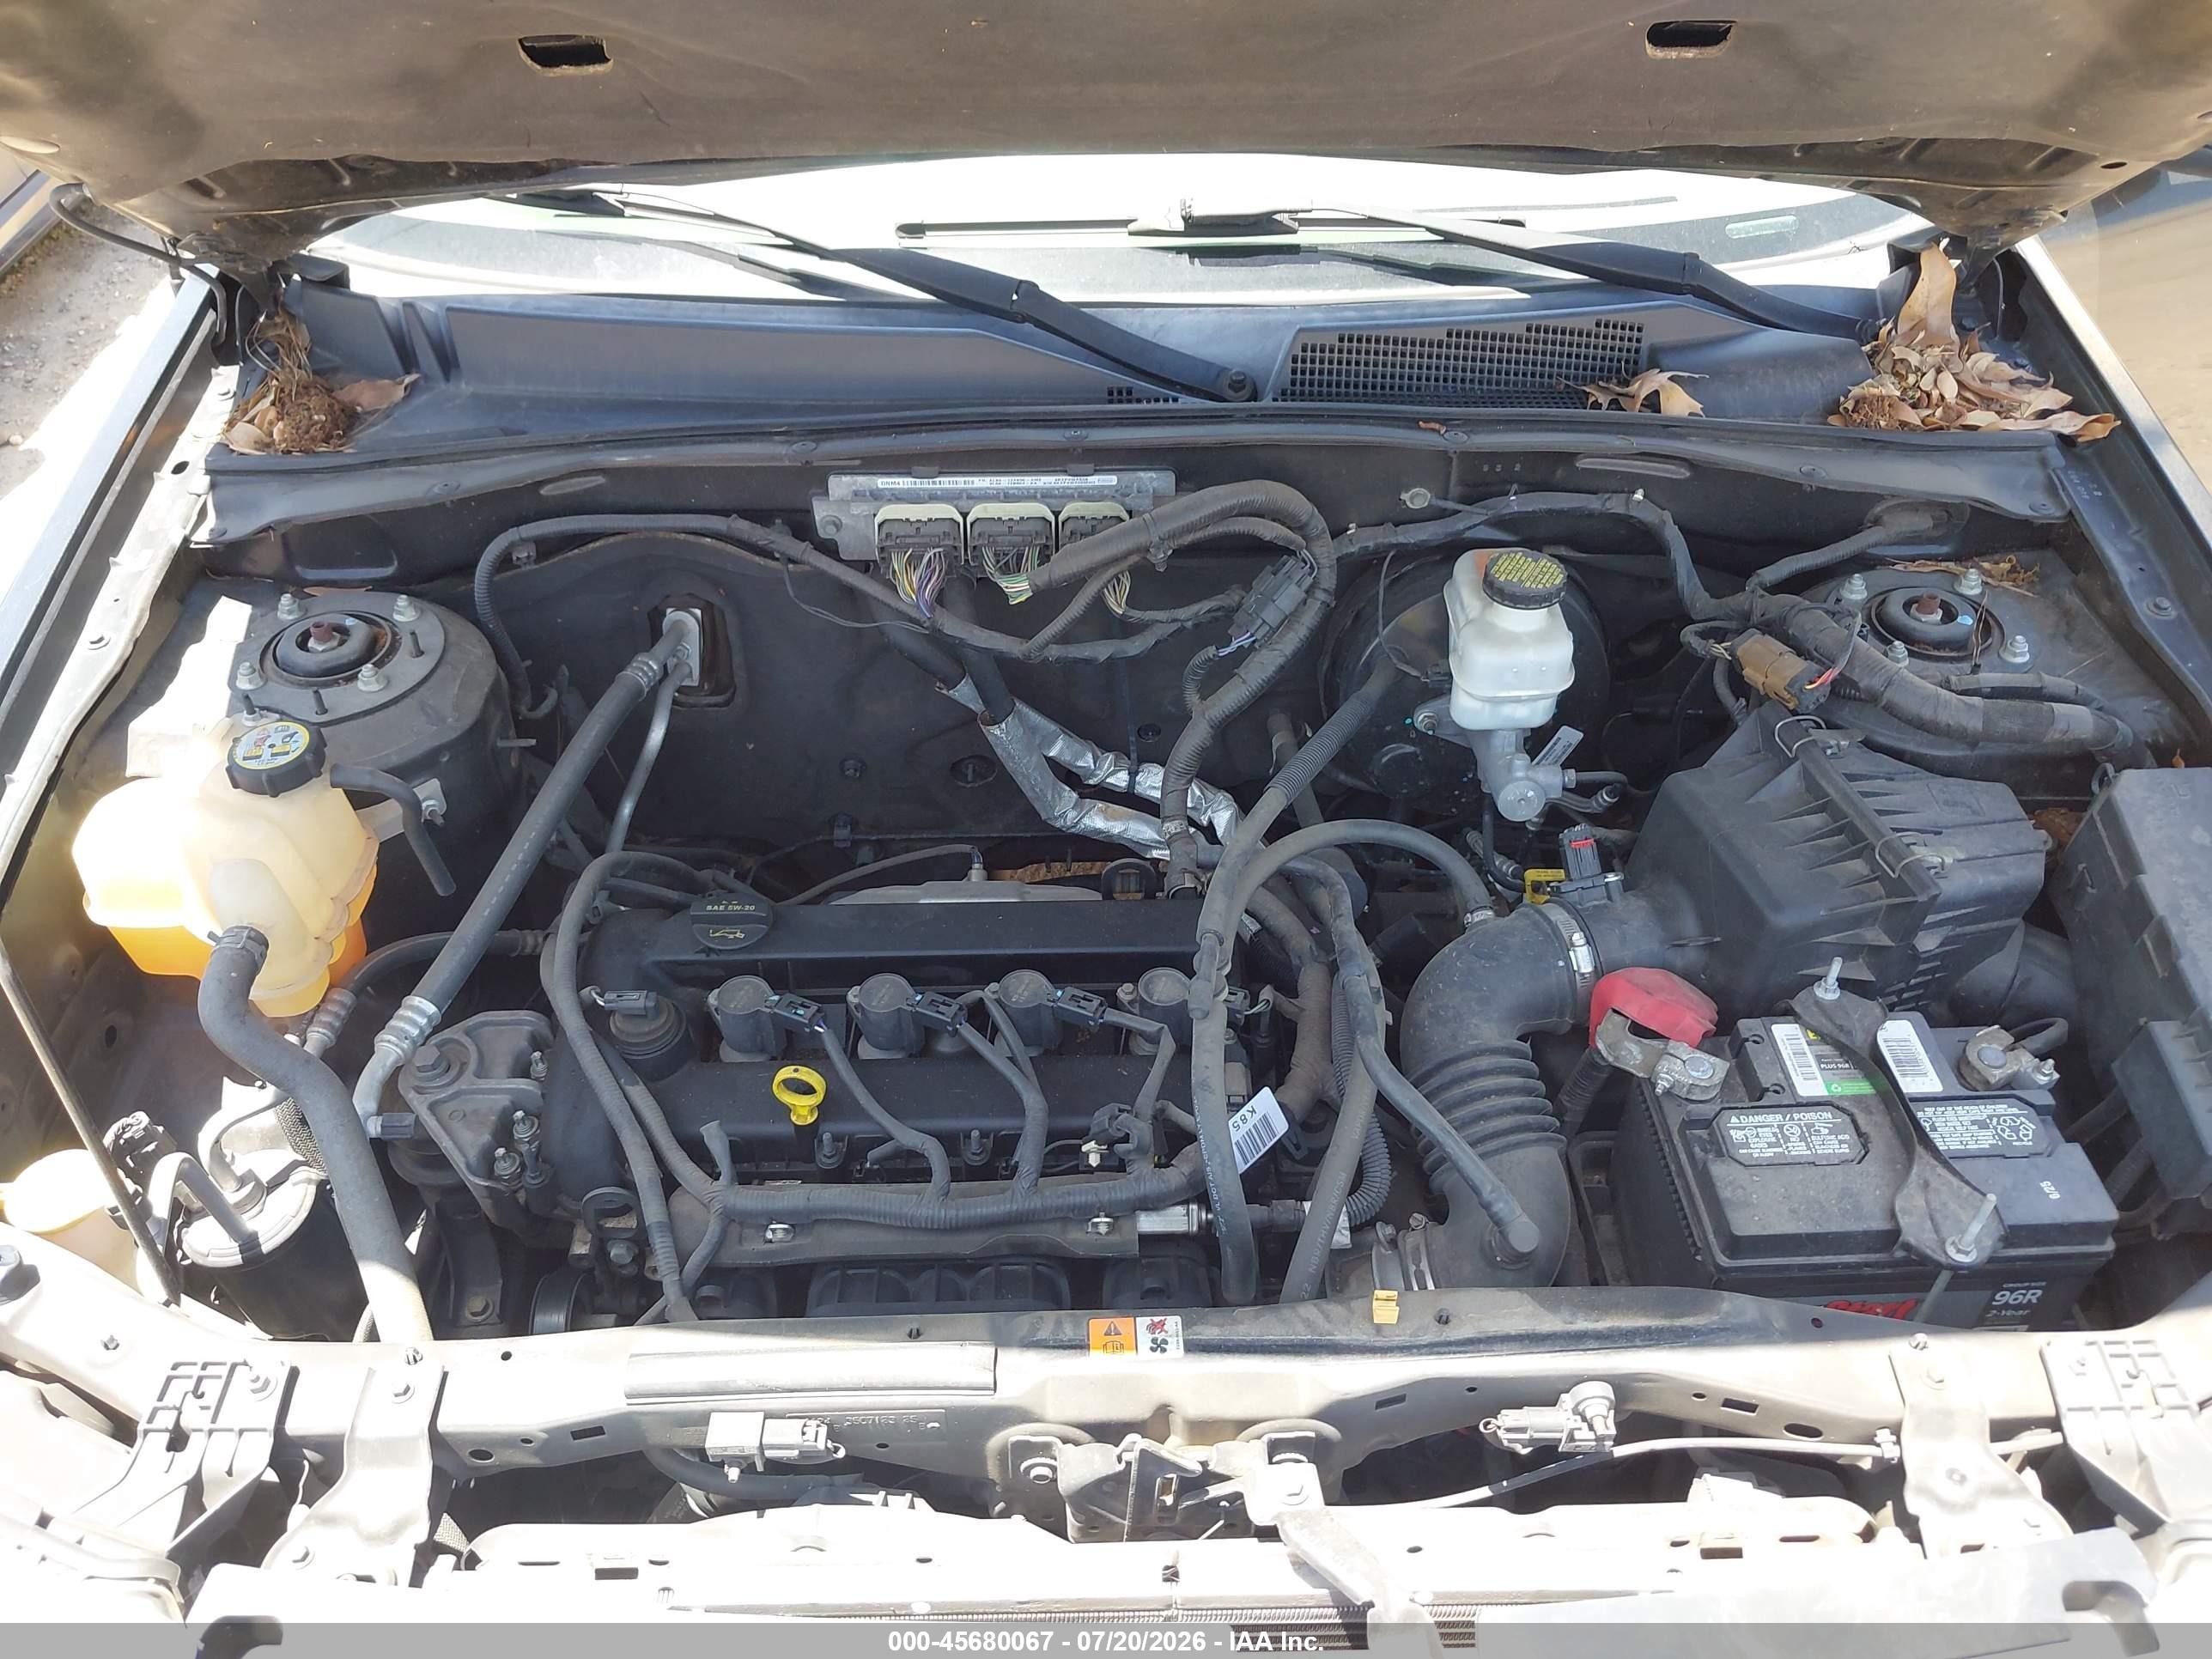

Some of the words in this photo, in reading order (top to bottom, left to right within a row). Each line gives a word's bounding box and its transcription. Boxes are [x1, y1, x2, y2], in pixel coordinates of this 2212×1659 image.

[1739, 1114, 1784, 1122] DANGER
[1785, 1113, 1791, 1121] /
[1792, 1111, 1833, 1121] POISON
[1991, 1289, 2044, 1305] 96R
